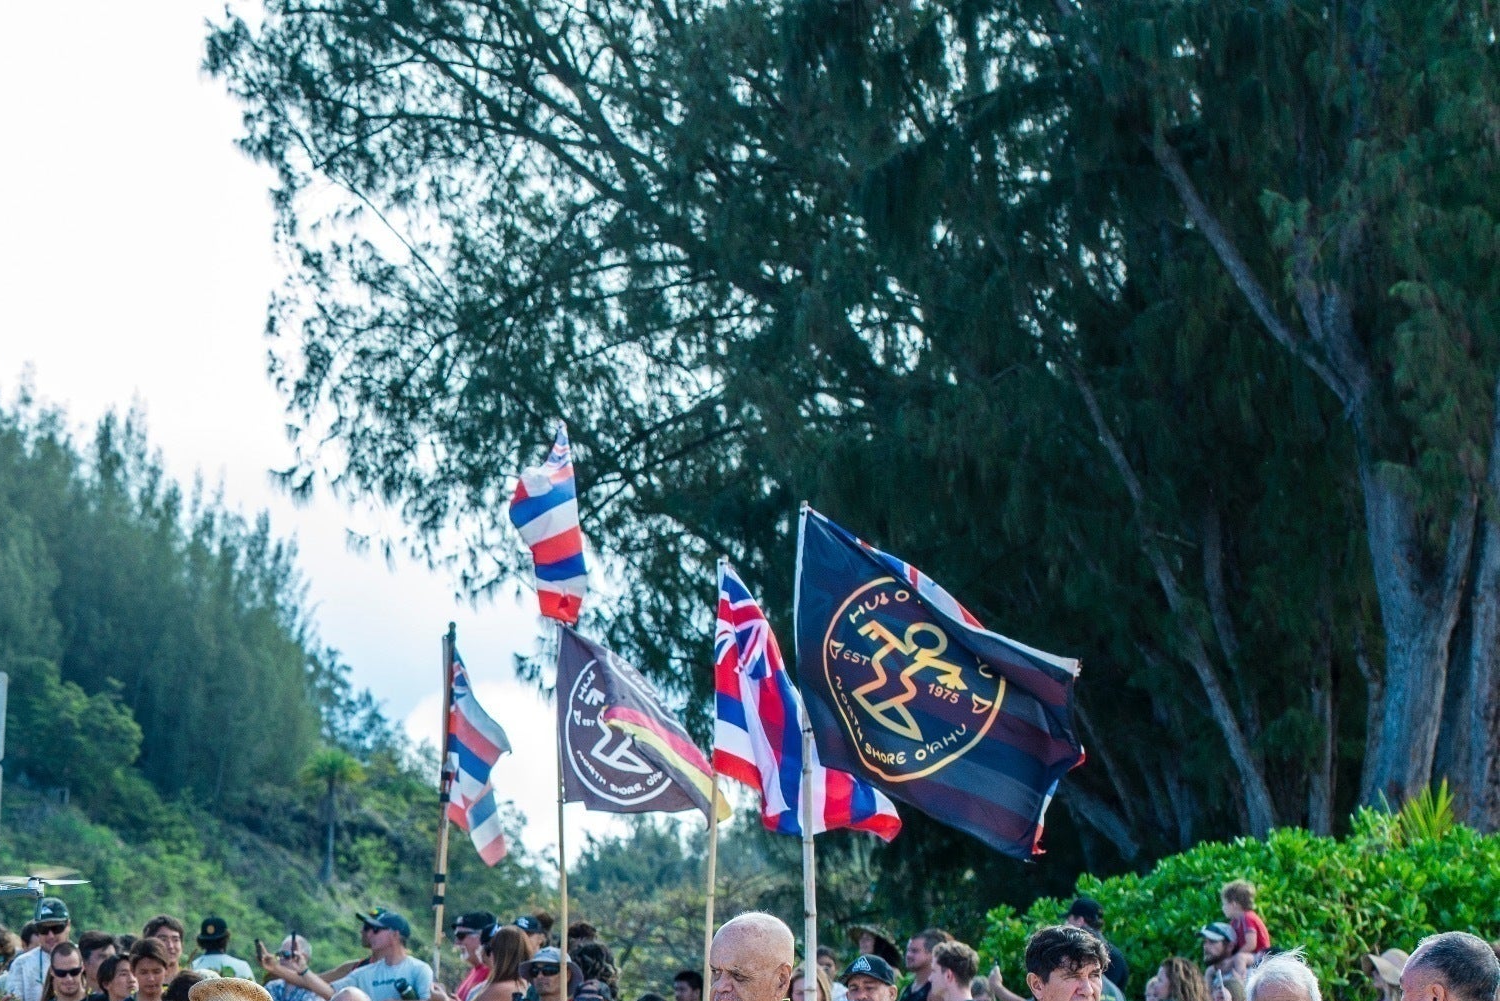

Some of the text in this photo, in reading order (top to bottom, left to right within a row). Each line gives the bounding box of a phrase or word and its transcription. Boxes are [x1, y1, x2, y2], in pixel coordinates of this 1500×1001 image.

[843, 649, 871, 666] EST
[928, 683, 960, 704] 1975
[864, 742, 907, 765] SHORE
